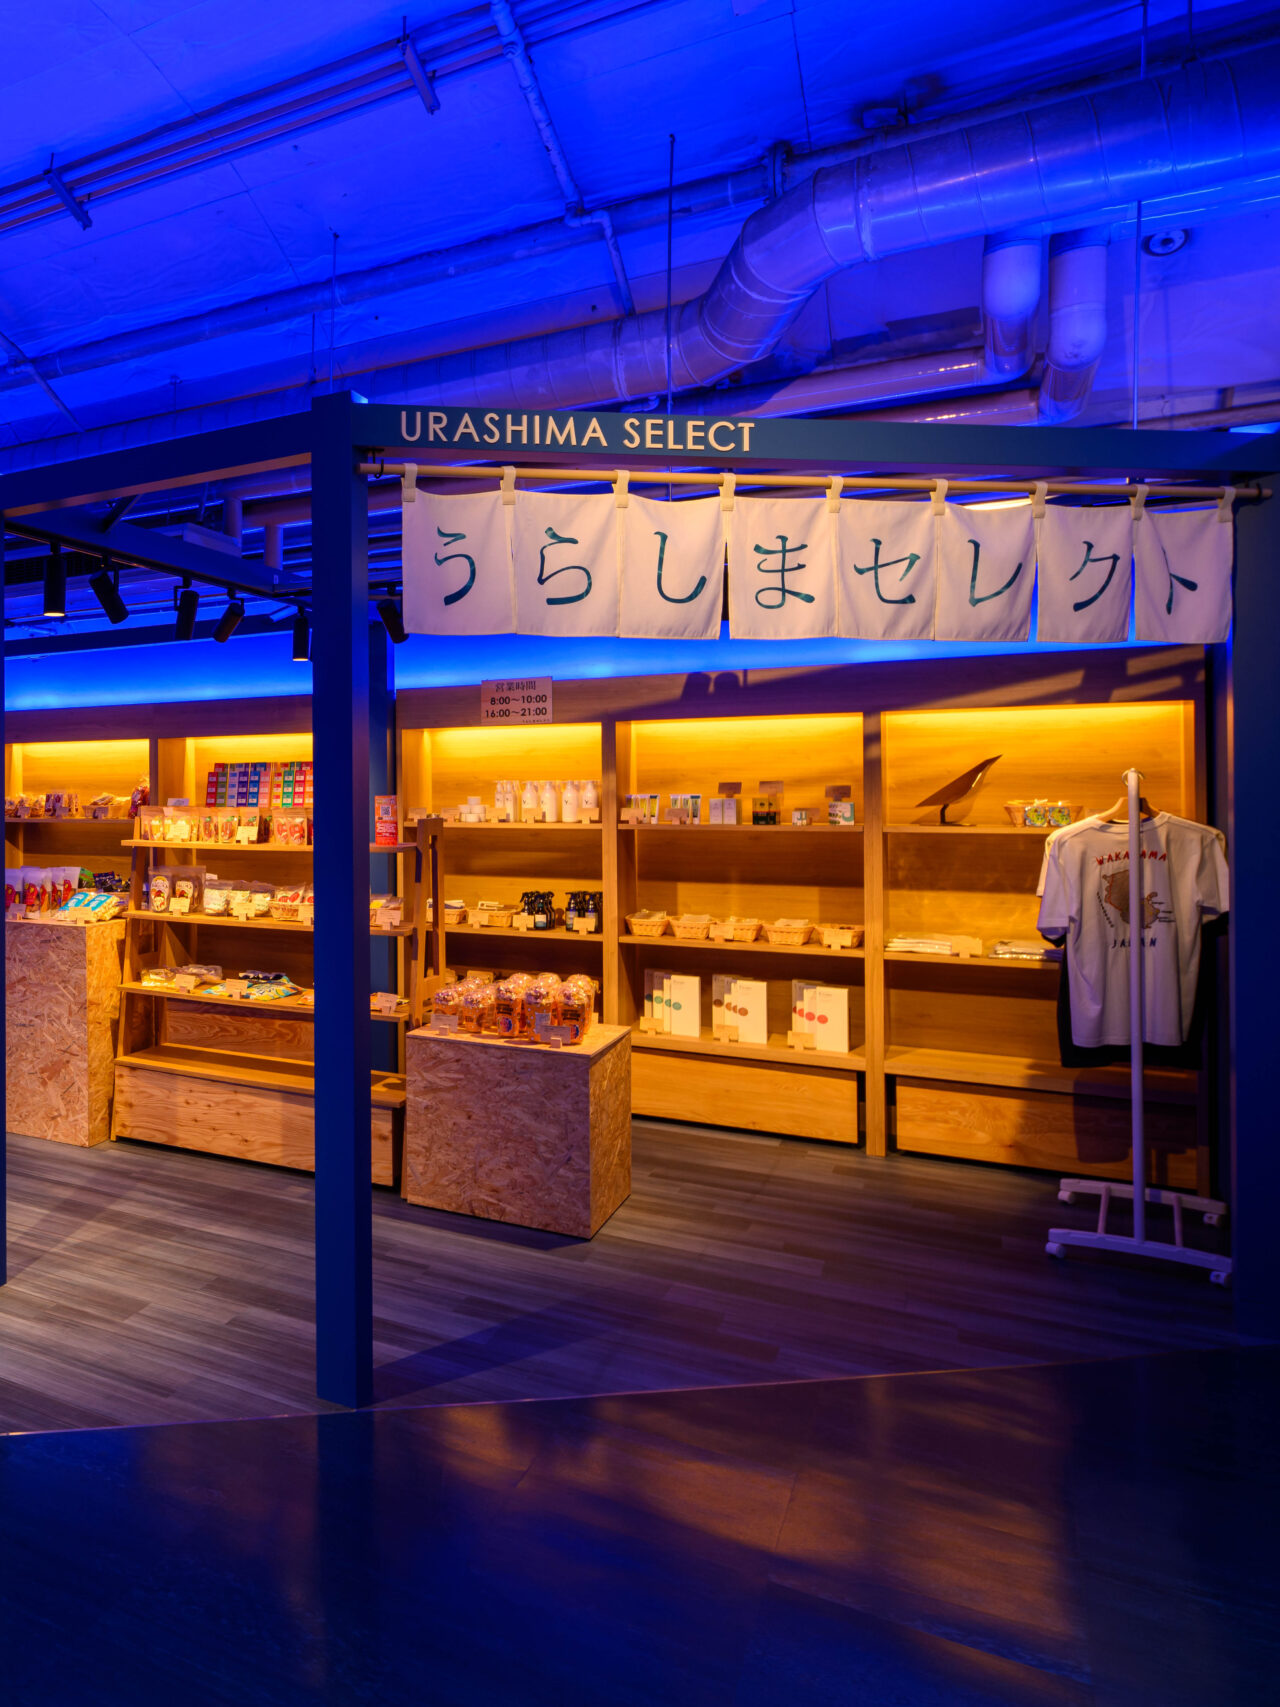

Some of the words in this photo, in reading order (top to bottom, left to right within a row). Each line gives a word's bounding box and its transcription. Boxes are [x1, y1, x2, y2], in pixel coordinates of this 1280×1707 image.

[401, 411, 608, 447] URASHIMA
[623, 417, 755, 452] SELECT
[433, 525, 1199, 615] うらしまセレクト
[495, 680, 537, 692] 営業時間
[1095, 849, 1167, 866] WAKAAMA
[1111, 937, 1157, 949] JAAN
